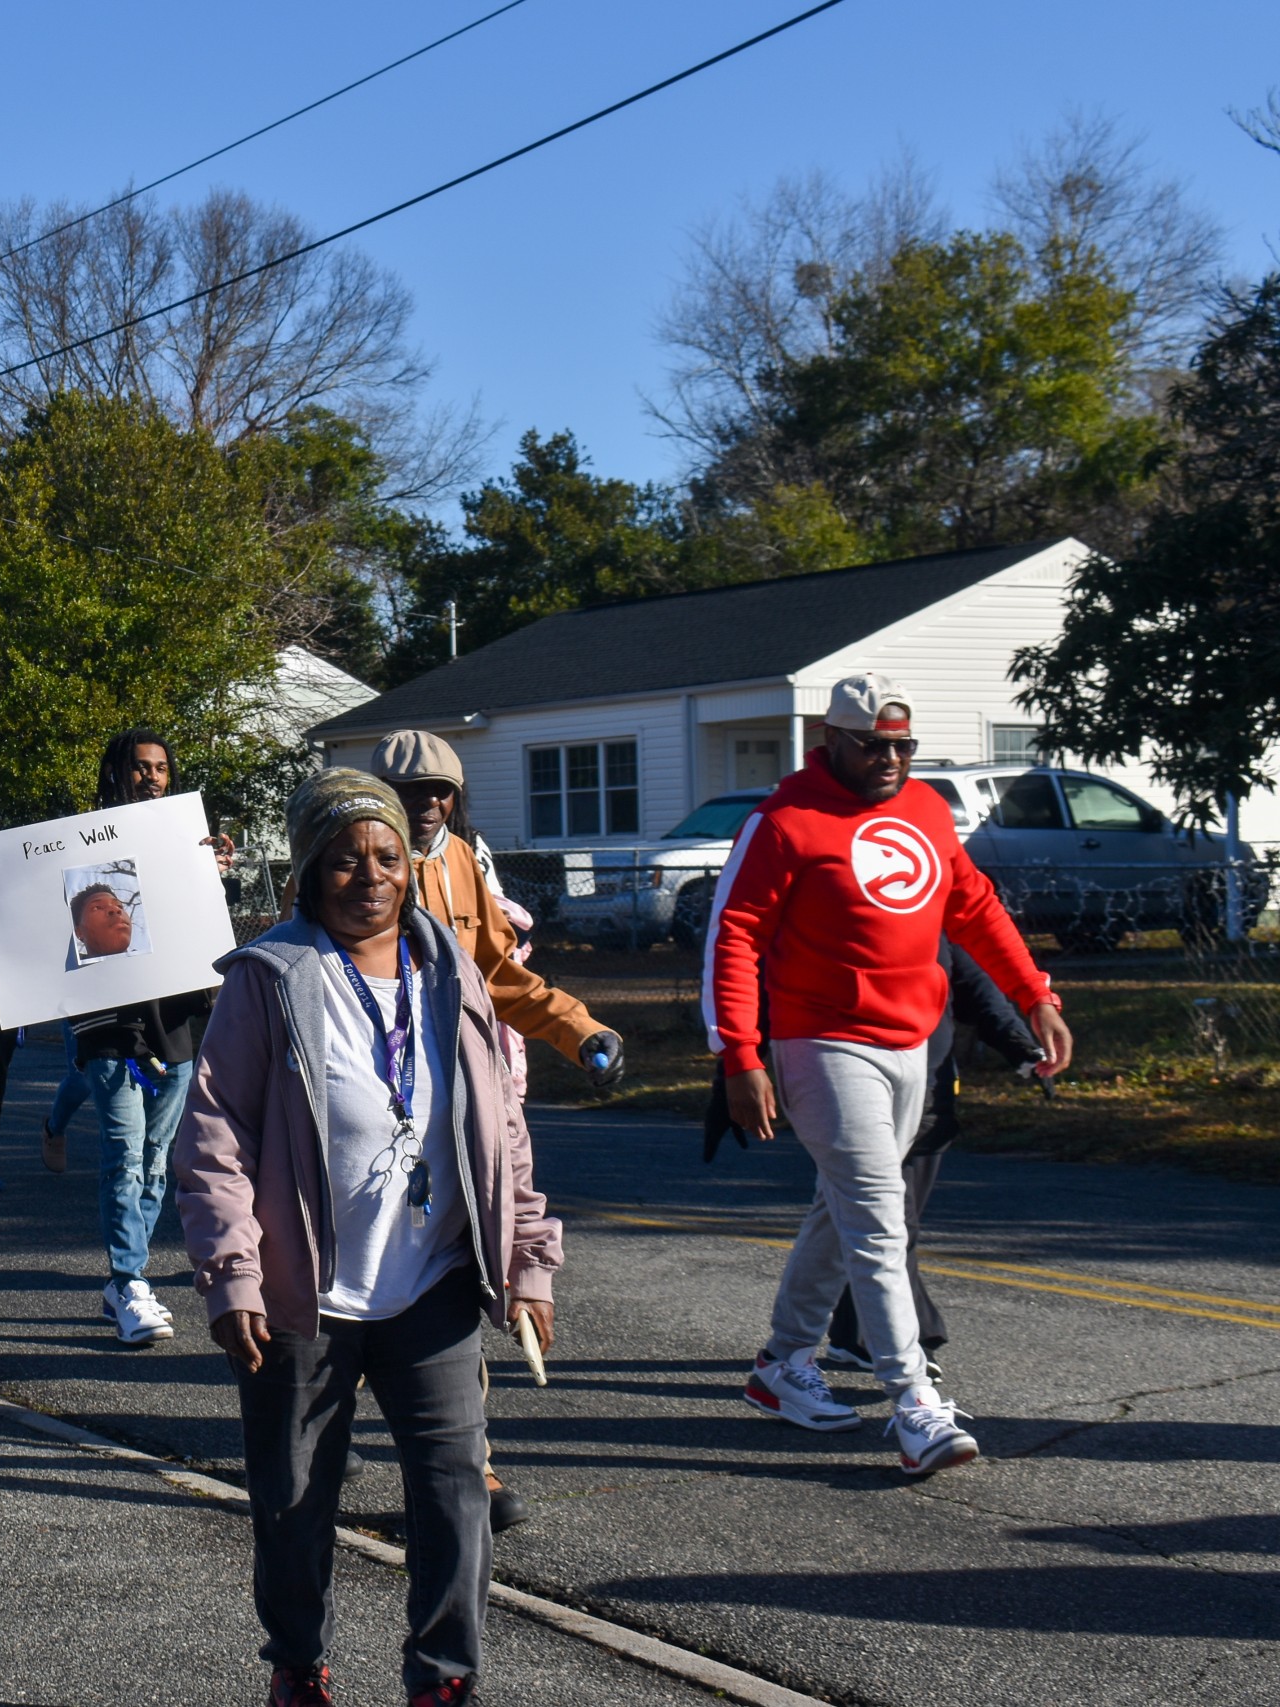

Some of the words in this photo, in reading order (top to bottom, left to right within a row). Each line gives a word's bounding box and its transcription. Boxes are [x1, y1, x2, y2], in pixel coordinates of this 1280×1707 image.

[22, 840, 66, 860] Peace
[78, 824, 119, 847] Walk
[343, 962, 373, 1009] Forever14
